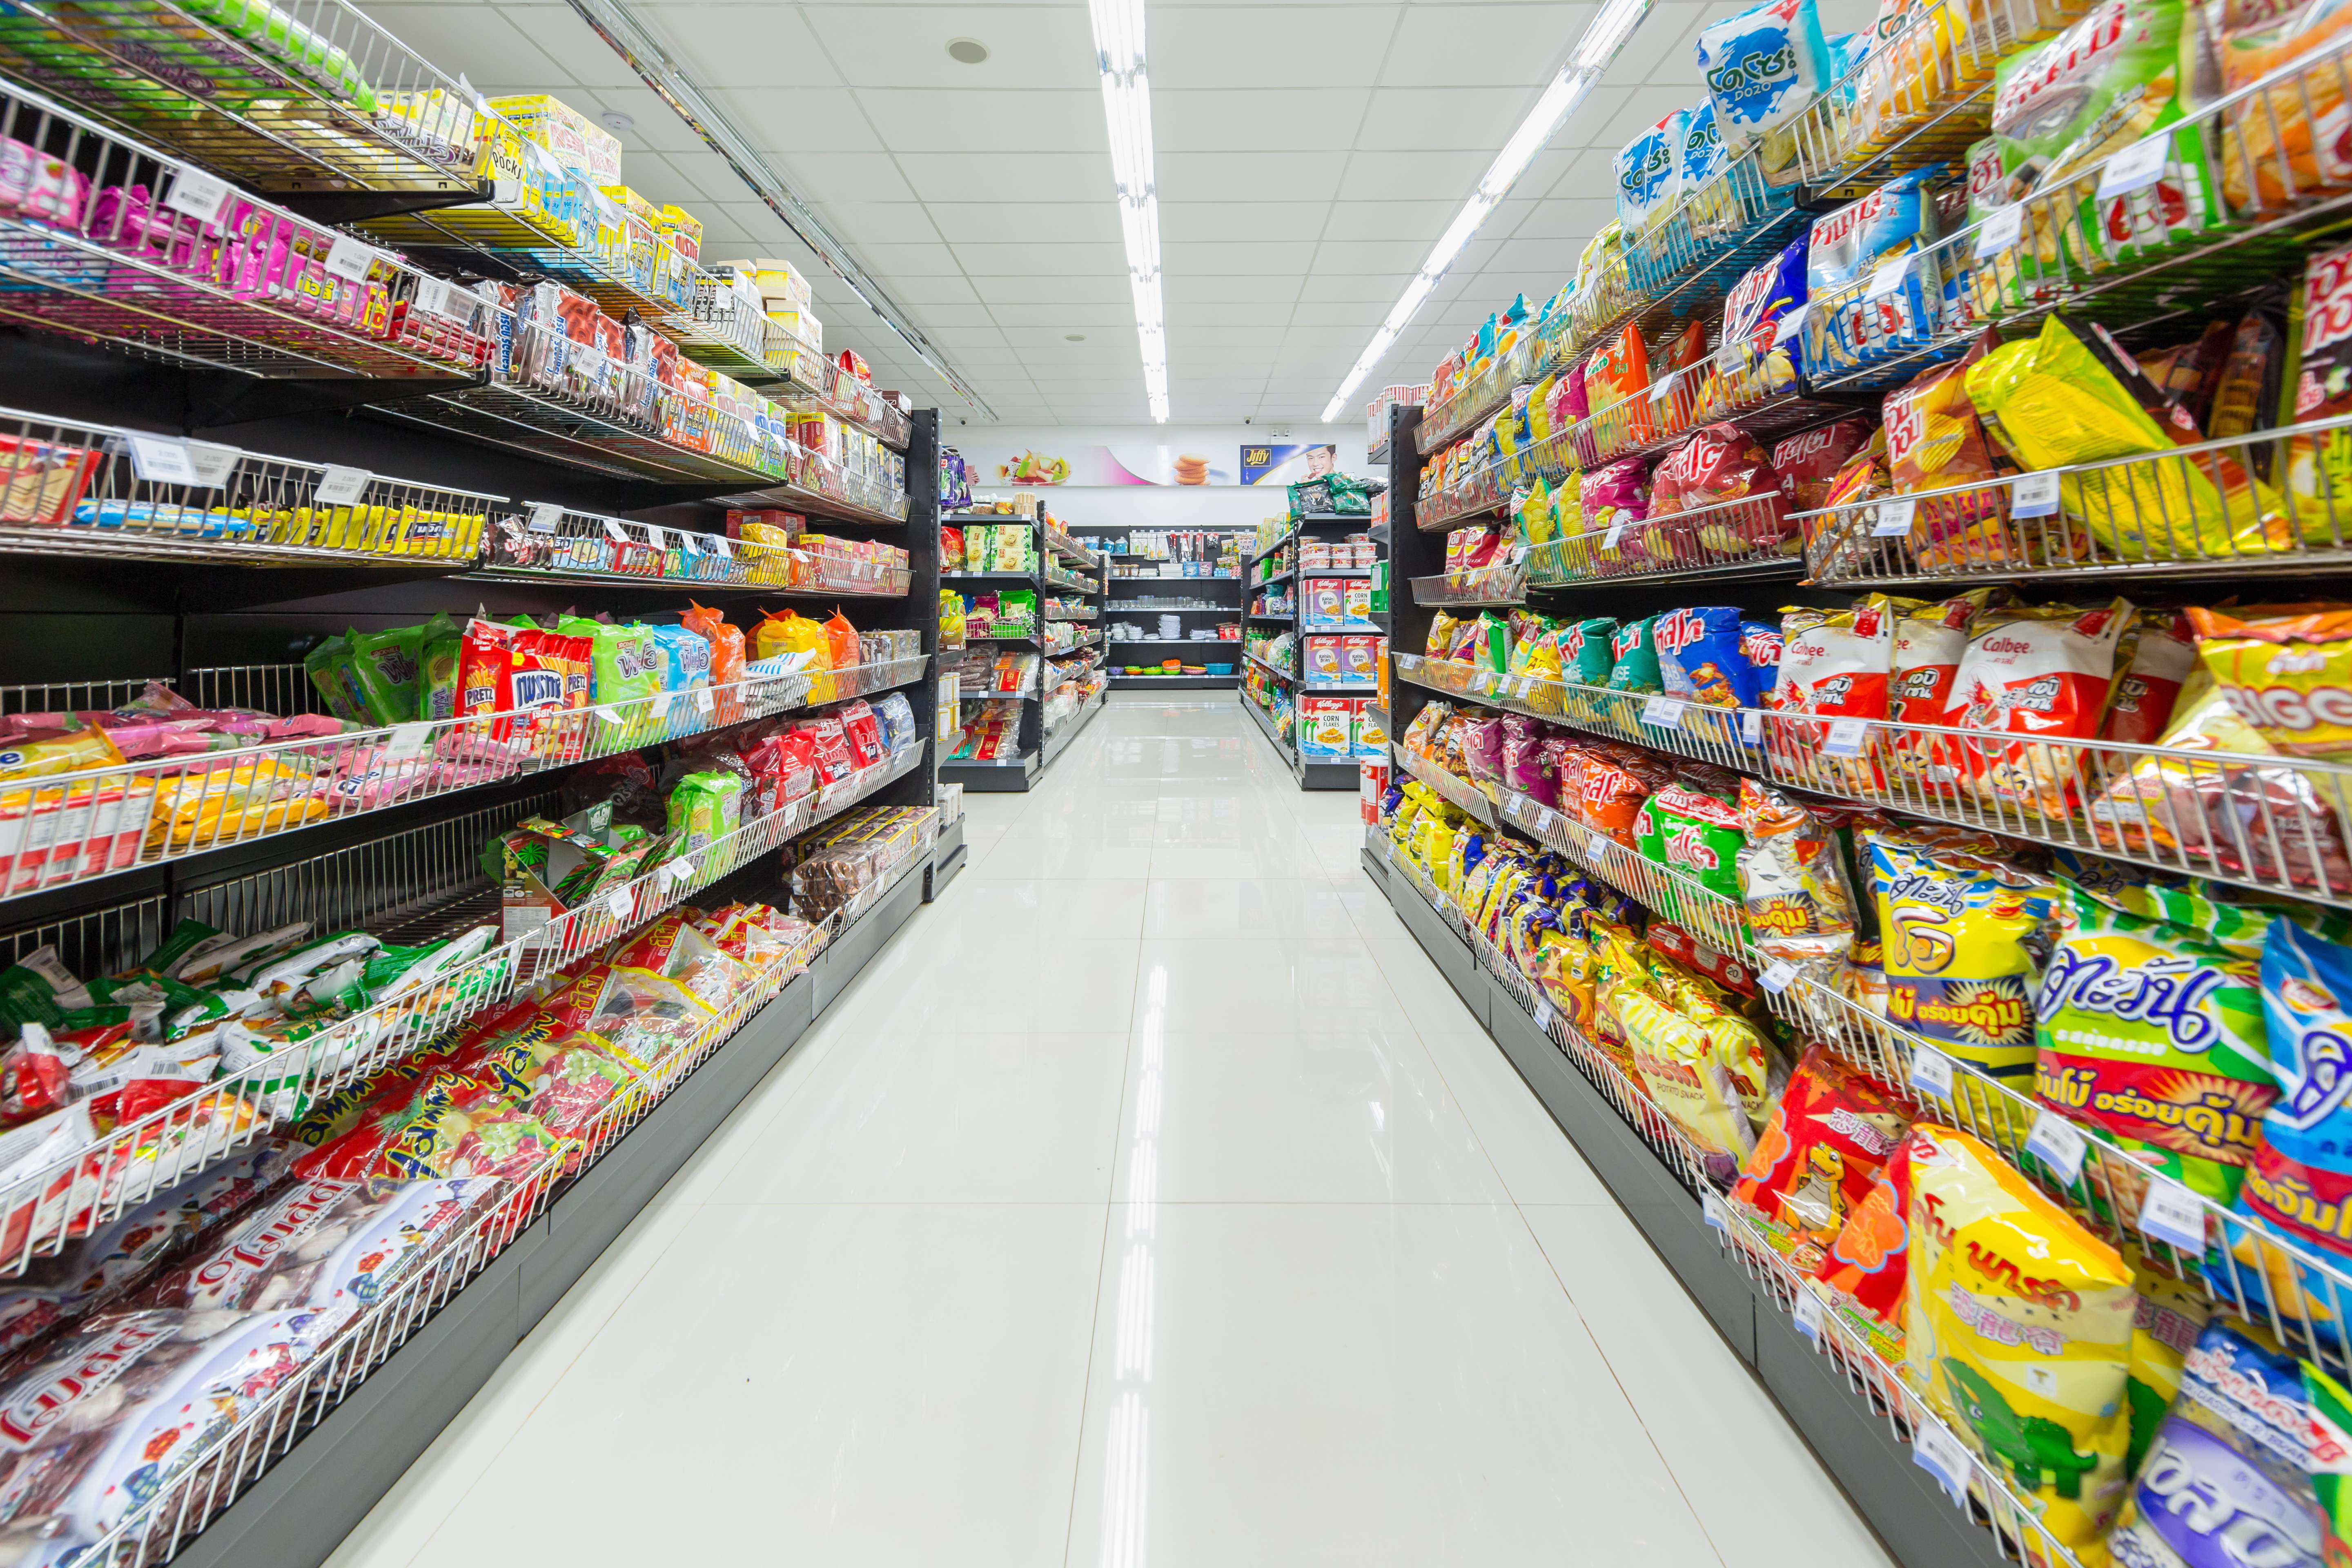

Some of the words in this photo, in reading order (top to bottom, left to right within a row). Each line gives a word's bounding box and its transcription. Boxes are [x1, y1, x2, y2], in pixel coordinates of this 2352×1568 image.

[1707, 49, 1797, 94] โดโซะ
[1735, 82, 1771, 101] DOZO
[1247, 450, 1270, 466] Jiffy
[1350, 581, 1371, 589] Kellogg's
[1314, 637, 1336, 645] Kellogg's
[1348, 637, 1370, 645] Kellogg's
[1791, 640, 1824, 657] Calbee
[1982, 636, 2030, 656] Calbee
[568, 675, 586, 692] PRETZ
[467, 688, 493, 705] PRETZ
[1316, 699, 1343, 710] Kellogg's
[2038, 948, 2226, 1051] ตะวัน
